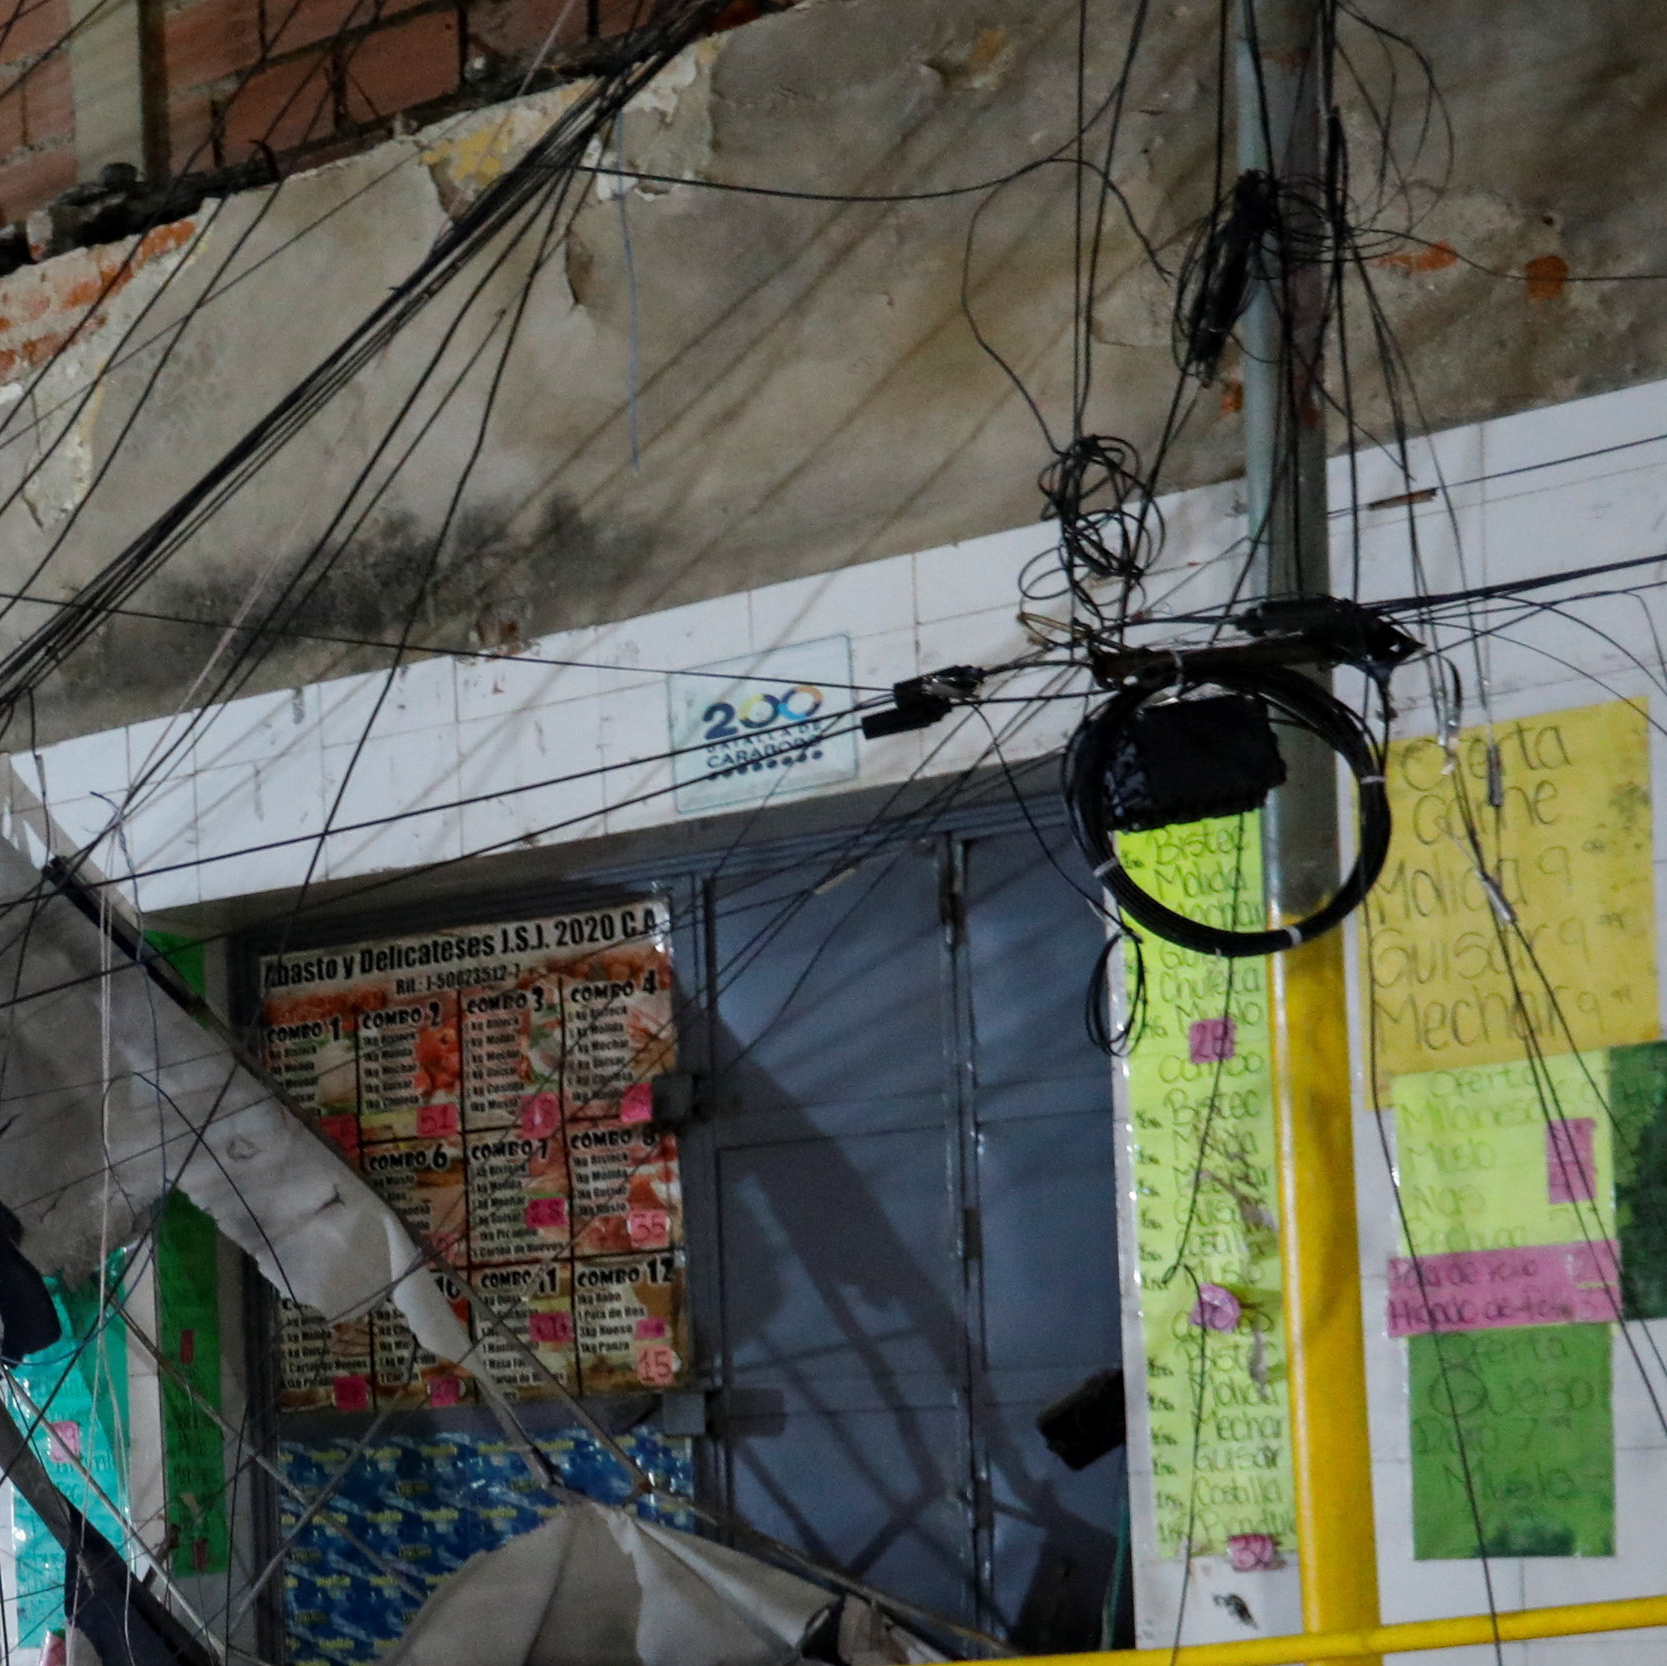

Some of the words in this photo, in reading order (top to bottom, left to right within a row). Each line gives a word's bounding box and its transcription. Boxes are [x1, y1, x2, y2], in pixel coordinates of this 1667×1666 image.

[701, 684, 824, 741] 200
[343, 957, 355, 980] y
[360, 935, 495, 975] Delicateses
[554, 915, 616, 948] 2020
[532, 986, 544, 1012] 3
[329, 1016, 342, 1042] 1
[362, 1008, 421, 1029] COMBO
[428, 1001, 442, 1027] 2
[369, 1152, 427, 1171] COMBO
[432, 1145, 448, 1169] 6
[577, 1267, 640, 1288] COMBO
[645, 1258, 675, 1284] 12
